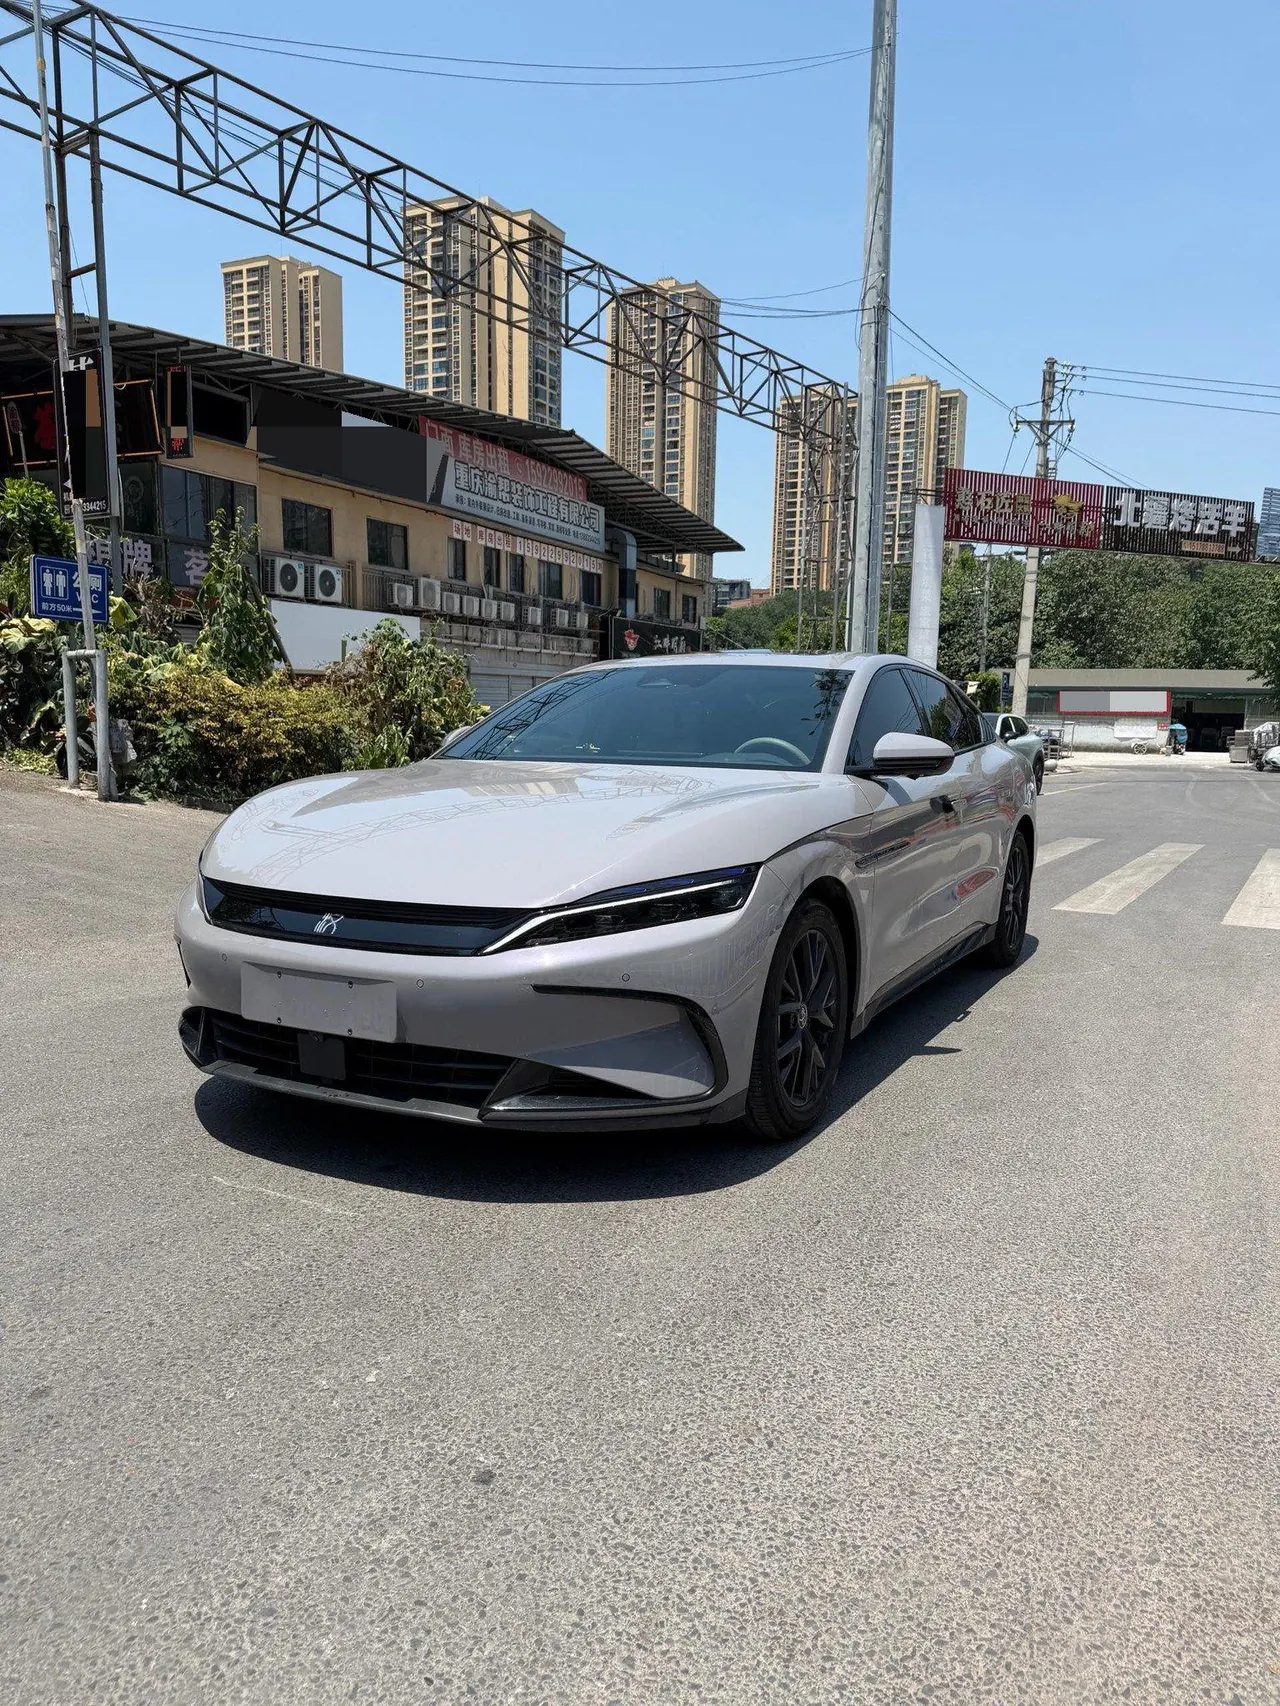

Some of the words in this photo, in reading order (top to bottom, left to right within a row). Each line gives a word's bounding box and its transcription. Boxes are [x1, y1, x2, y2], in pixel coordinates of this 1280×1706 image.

[458, 433, 509, 475] 库房出租
[454, 460, 600, 533] 重庆渝帮装饰工程有限公司
[453, 522, 471, 538] 场地
[41, 602, 73, 613] 前方50米
